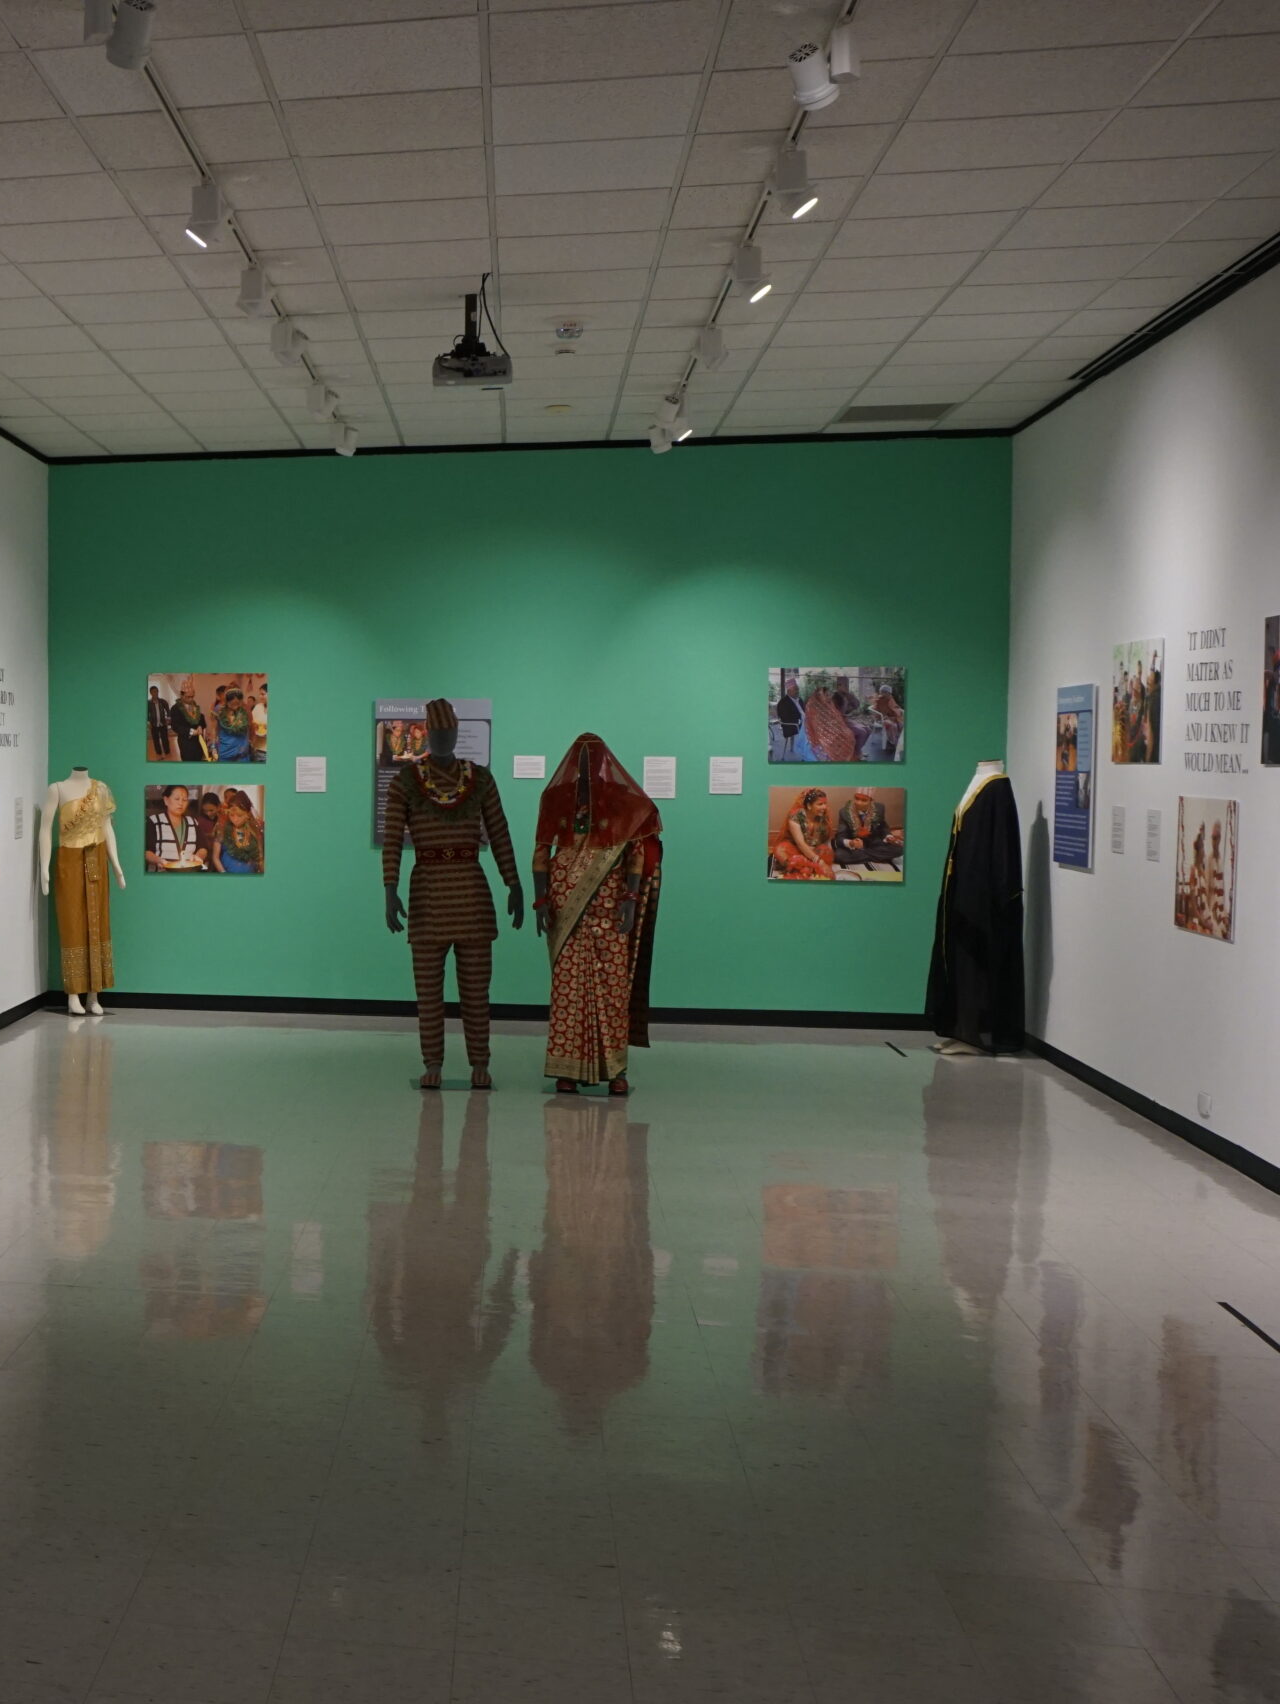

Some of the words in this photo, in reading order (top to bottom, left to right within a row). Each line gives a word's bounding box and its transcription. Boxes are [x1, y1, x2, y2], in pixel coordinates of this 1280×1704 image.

[1186, 662, 1220, 681] MATTER
[1222, 660, 1234, 679] AS
[8, 691, 15, 706] TO
[1186, 692, 1210, 712] MUCH
[1214, 692, 1225, 711] TO
[1227, 691, 1242, 710] ME
[379, 705, 418, 715] Following
[1185, 723, 1202, 742] AND
[1210, 724, 1237, 743] KNEW
[1240, 724, 1250, 743] IT
[1184, 752, 1214, 772] WOULD
